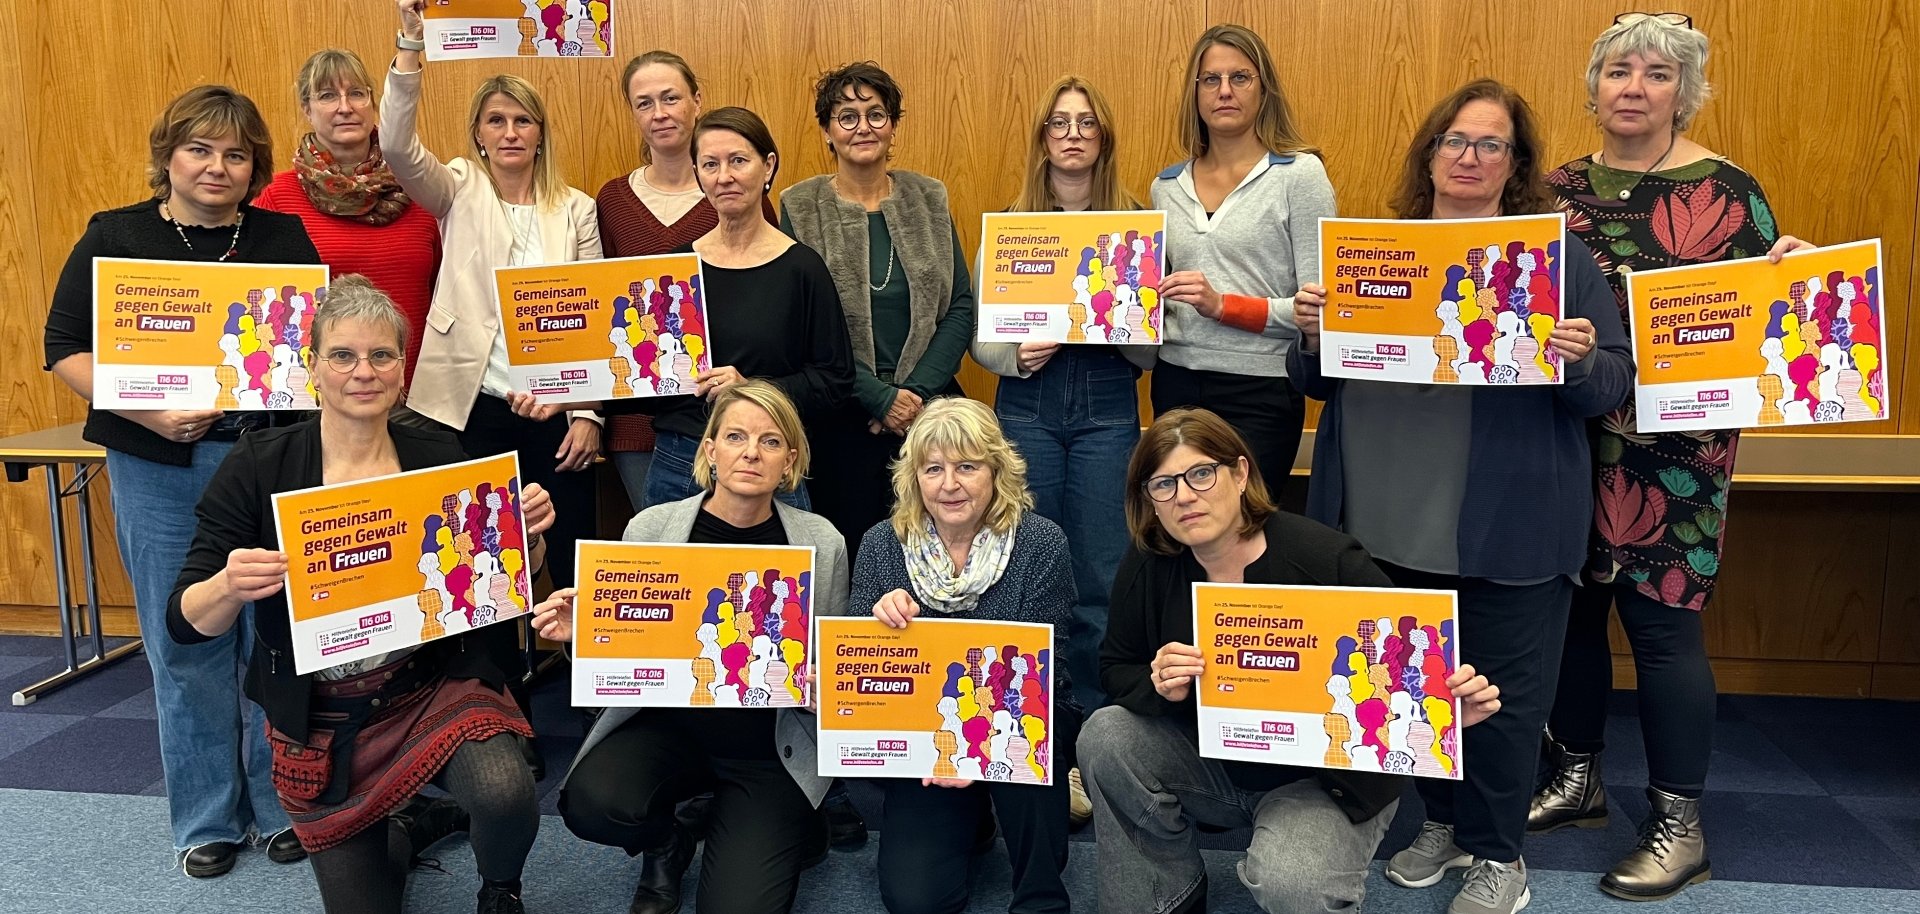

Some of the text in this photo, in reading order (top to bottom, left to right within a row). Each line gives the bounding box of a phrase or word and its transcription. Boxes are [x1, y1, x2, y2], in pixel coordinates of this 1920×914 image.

[997, 234, 1059, 244] Gemeinsam
[996, 247, 1069, 259] gegen Gewalt
[1337, 246, 1415, 260] Gemeinsam
[1015, 262, 1052, 272] Frauen
[1336, 264, 1429, 278] gegen Gewalt
[115, 284, 199, 298] Gemeinsam
[514, 288, 586, 300] Gemeinsam
[1337, 282, 1407, 295] an Frauen
[114, 301, 212, 313] gegen Gewalt
[1651, 292, 1737, 309] Gemeinsam
[516, 299, 599, 317] gegen Gewalt
[115, 317, 190, 329] an Frauen
[1651, 305, 1752, 328] gegen Gewalt
[519, 318, 582, 331] an Frauen
[1653, 328, 1729, 344] an Frauen
[302, 508, 392, 534] Gemeinsam
[304, 521, 407, 556] gegen Gewalt
[307, 547, 386, 573] an Frauen
[595, 569, 678, 583] Gemeinsam
[593, 587, 691, 601] gegen Gewalt
[594, 605, 669, 618] an Frauen
[362, 614, 389, 627] 116 016
[1215, 613, 1303, 629] Gemeinsam
[332, 625, 392, 643] Gewalt gegen Frauen
[1214, 633, 1318, 648] gegen Gewalt
[836, 644, 918, 657] Gemeinsam
[1216, 652, 1295, 668] an Frauen
[836, 661, 931, 675] gegen Gewalt
[837, 679, 909, 692] an Frauen
[1264, 723, 1291, 733] 116 016
